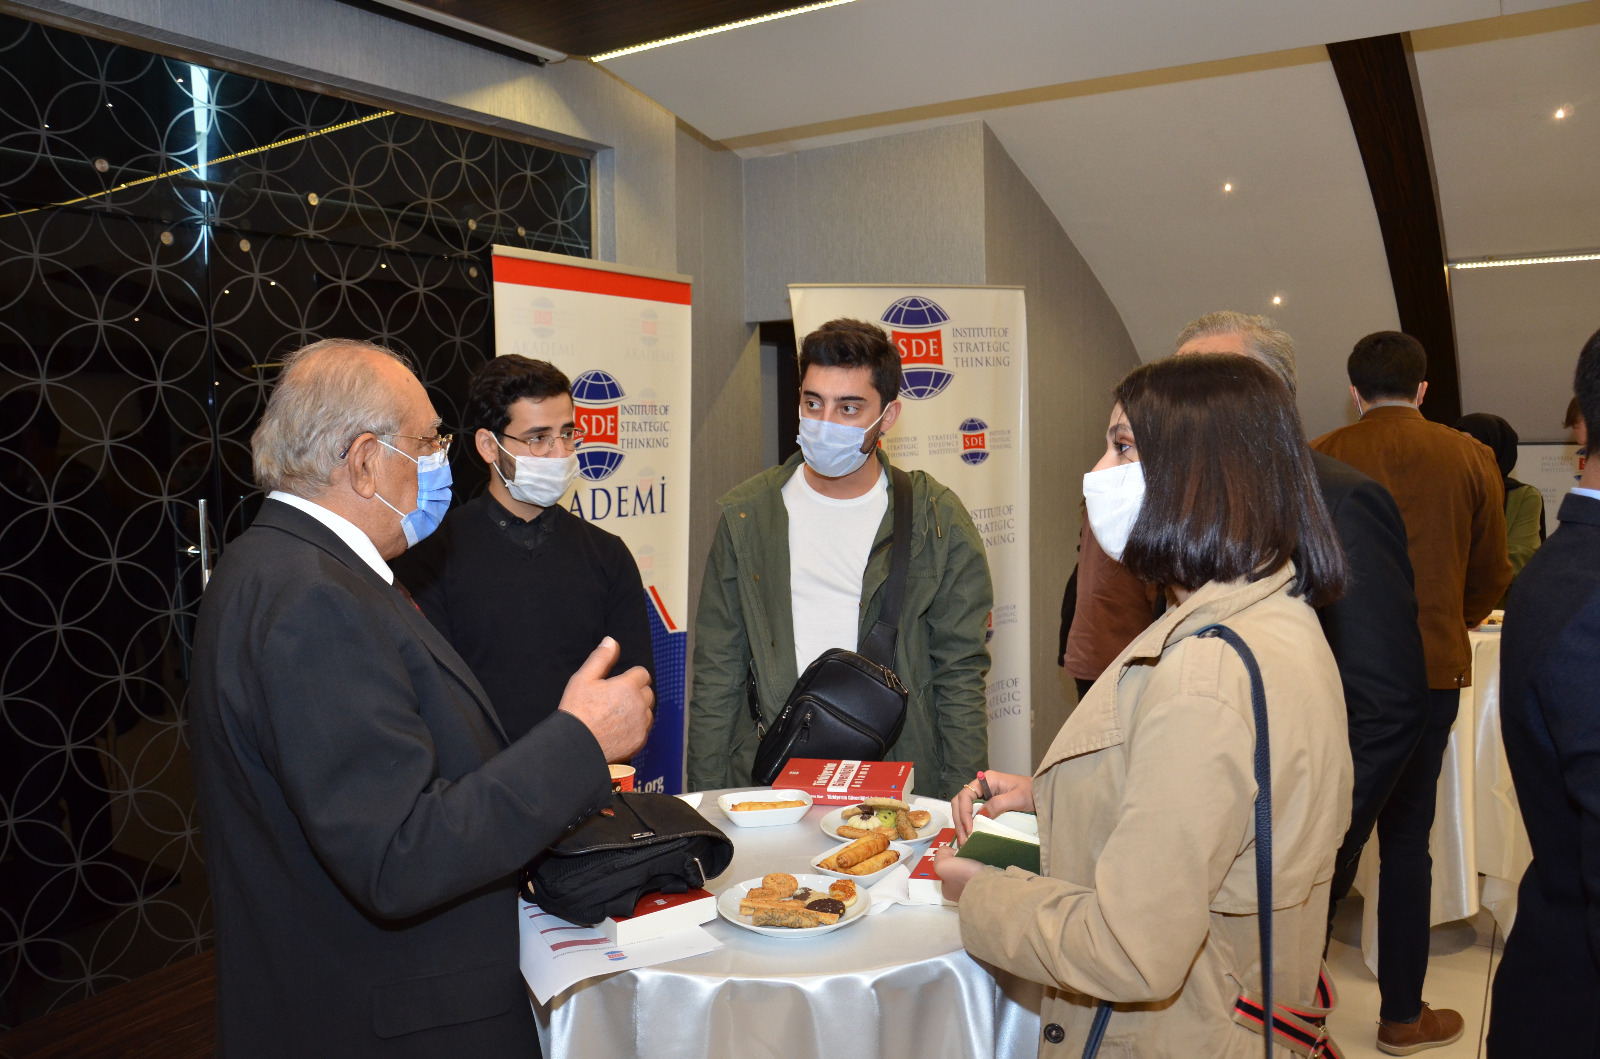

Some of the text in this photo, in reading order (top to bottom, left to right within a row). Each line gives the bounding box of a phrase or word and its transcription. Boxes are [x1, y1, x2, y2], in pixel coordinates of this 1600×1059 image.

[952, 327, 1009, 338] INSTITUTE OF
[898, 338, 939, 358] SDE
[953, 341, 1010, 353] STRATEGIC
[954, 356, 1010, 368] THINKING
[620, 404, 669, 416] INSTITUTE OF
[580, 414, 615, 436] SDE
[620, 421, 669, 433] STRATEGIC
[620, 438, 669, 449] THINKING
[887, 443, 918, 451] STRATEGIC
[965, 436, 984, 447] SDE
[569, 475, 667, 520] ADEMİ
[971, 504, 1014, 520] STITUTE OF
[976, 518, 1015, 533] RATEGIC
[985, 532, 1015, 548] NKING
[1006, 677, 1019, 689] OF
[987, 691, 1021, 708] ATEGIC
[988, 704, 1021, 722] NKING
